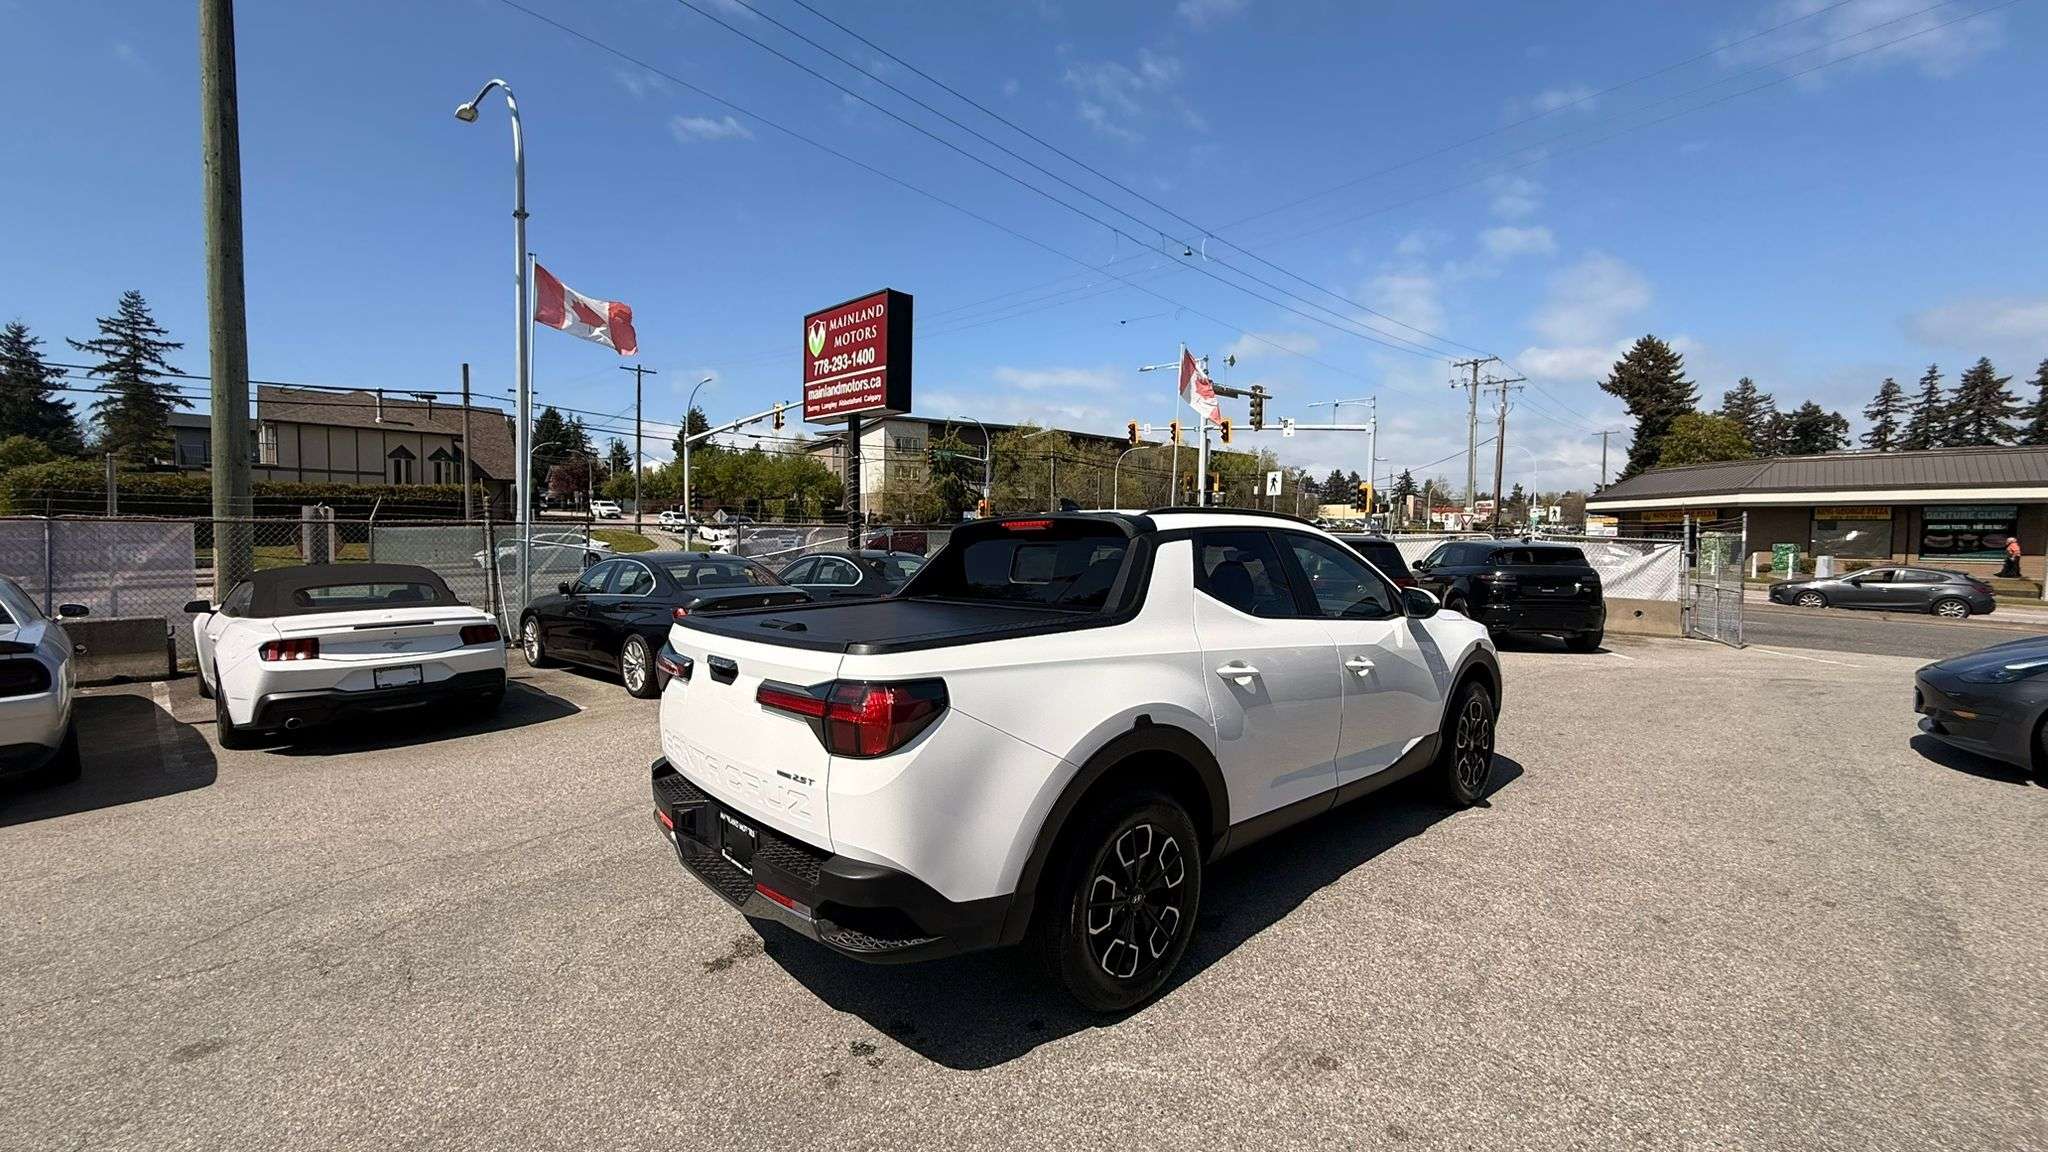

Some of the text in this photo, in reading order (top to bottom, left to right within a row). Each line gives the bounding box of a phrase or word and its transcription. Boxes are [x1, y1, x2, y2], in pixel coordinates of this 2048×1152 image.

[829, 303, 884, 331] MAINLAND
[834, 324, 877, 348] MOTORS
[813, 347, 875, 377] 778-293-1400
[807, 375, 882, 401] mainlandmotors.ca
[863, 394, 882, 403] Calgary
[1977, 511, 2014, 520] CLINIC
